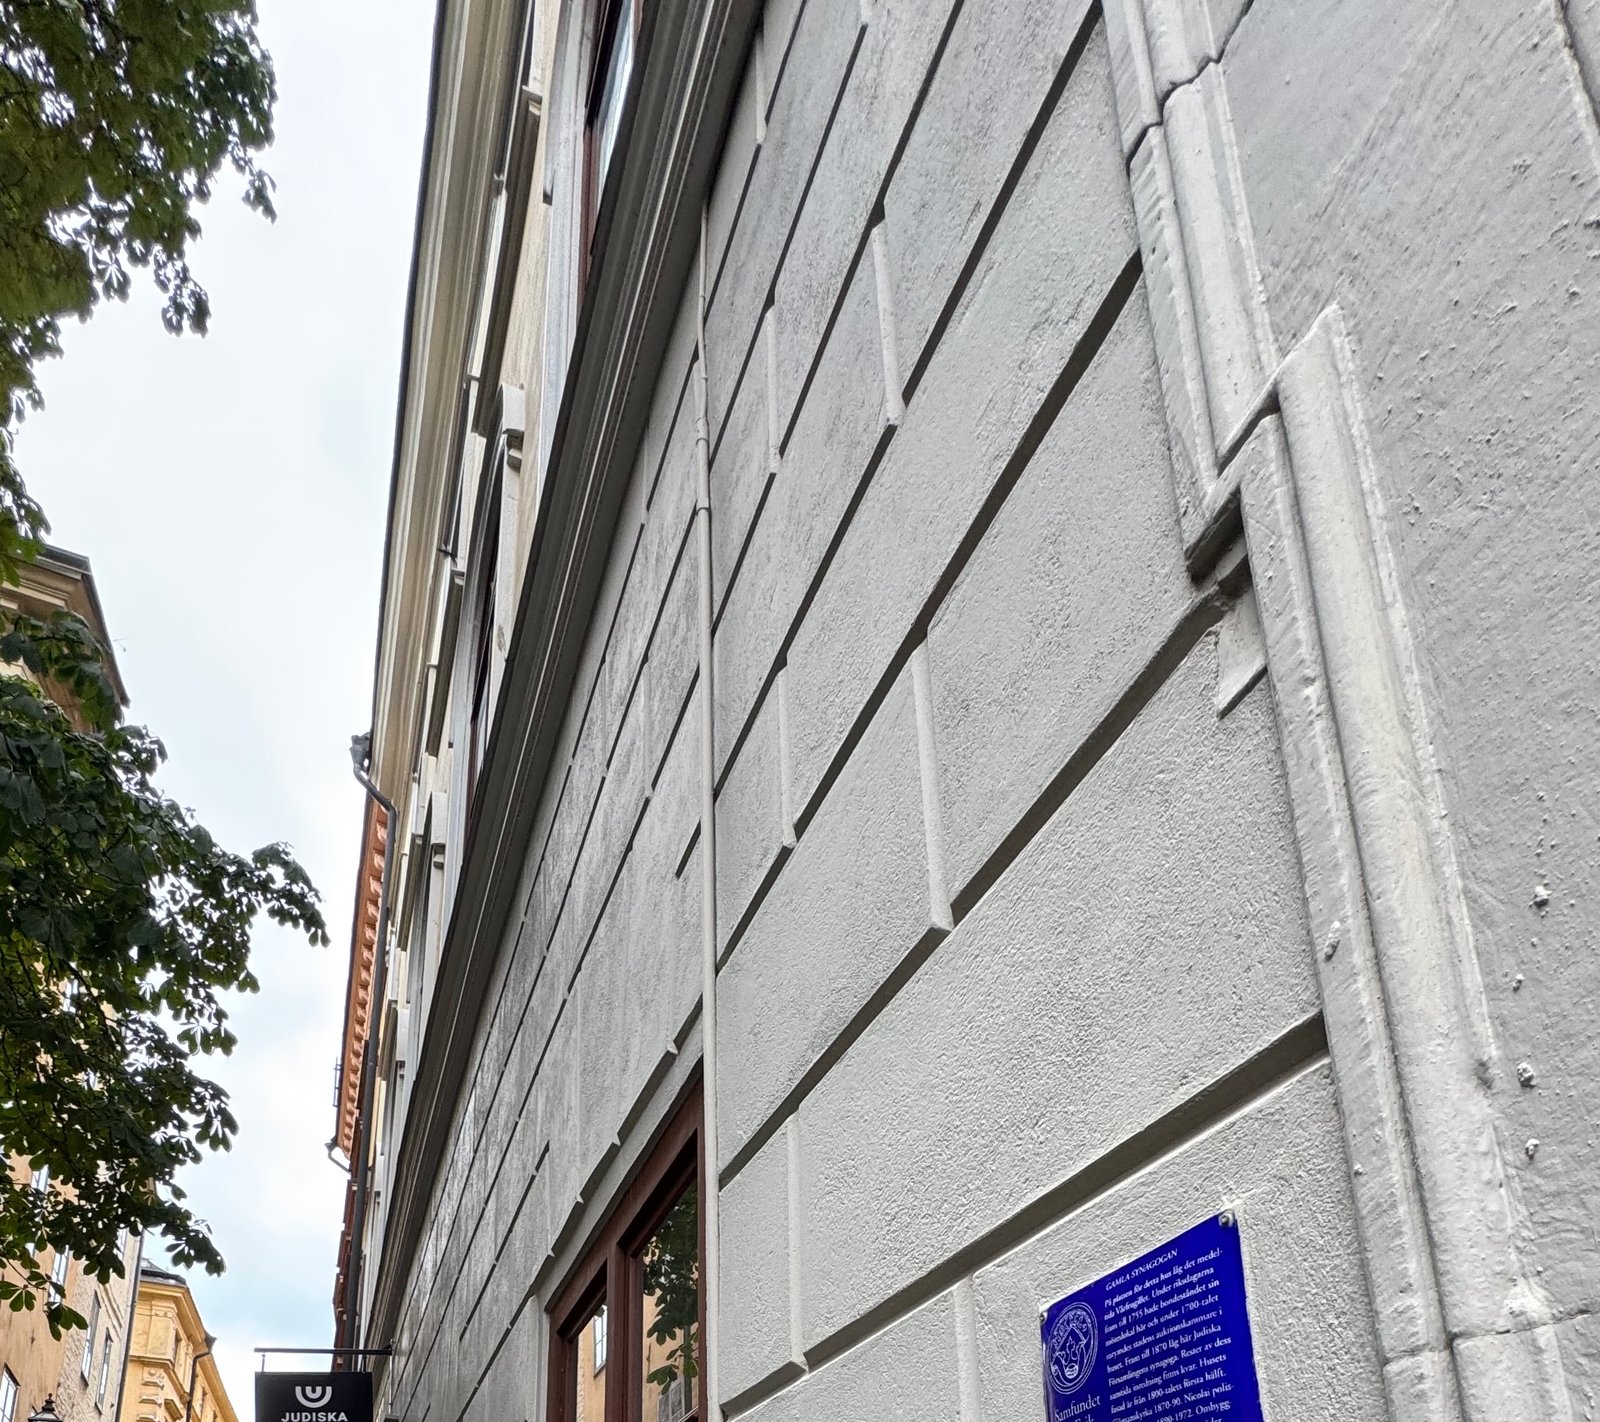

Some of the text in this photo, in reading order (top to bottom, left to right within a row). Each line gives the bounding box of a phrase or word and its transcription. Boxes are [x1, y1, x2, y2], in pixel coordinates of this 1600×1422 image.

[1106, 1248, 1177, 1290] GAMLA SYNAGOGAN
[1144, 1277, 1159, 1289] detta
[1160, 1271, 1171, 1281] hus
[1173, 1265, 1183, 1275] låg
[1184, 1259, 1195, 1270] det
[1197, 1248, 1223, 1264] medel-
[1152, 1284, 1171, 1297] Under
[1173, 1267, 1214, 1289] riksdagarna
[1128, 1309, 1142, 1323] 1755
[1144, 1303, 1159, 1315] hade
[1160, 1284, 1205, 1308] bondeståndet
[1208, 1279, 1219, 1289] sin
[1136, 1324, 1146, 1333] här
[1148, 1317, 1158, 1328] och
[1160, 1310, 1179, 1322] under
[1182, 1294, 1218, 1313] 1700-talet
[1125, 1354, 1140, 1366] Fram
[1142, 1348, 1150, 1359] till
[1152, 1343, 1167, 1355] 1870
[1169, 1339, 1179, 1348] låg
[1180, 1334, 1192, 1343] här
[1194, 1324, 1221, 1341] Judiska
[1133, 1335, 1155, 1348] stadens
[1156, 1312, 1217, 1338] auktionskammare
[1220, 1306, 1222, 1315] i
[1150, 1355, 1179, 1372] synagoga.
[1181, 1346, 1202, 1358] Rester
[1214, 1337, 1231, 1347] dess
[1163, 1370, 1179, 1380] finns
[1181, 1363, 1197, 1374] kvar.
[1200, 1354, 1226, 1367] Husets
[1134, 1396, 1146, 1405] från
[1183, 1377, 1204, 1388] första
[1206, 1368, 1226, 1380] hälft.
[1154, 1398, 1183, 1413] 1870-90.
[1184, 1388, 1210, 1403] Nicolai
[1212, 1382, 1234, 1397] polis-
[281, 1412, 348, 1422] JUDISKA
[1196, 1400, 1232, 1415] Ombygg-
